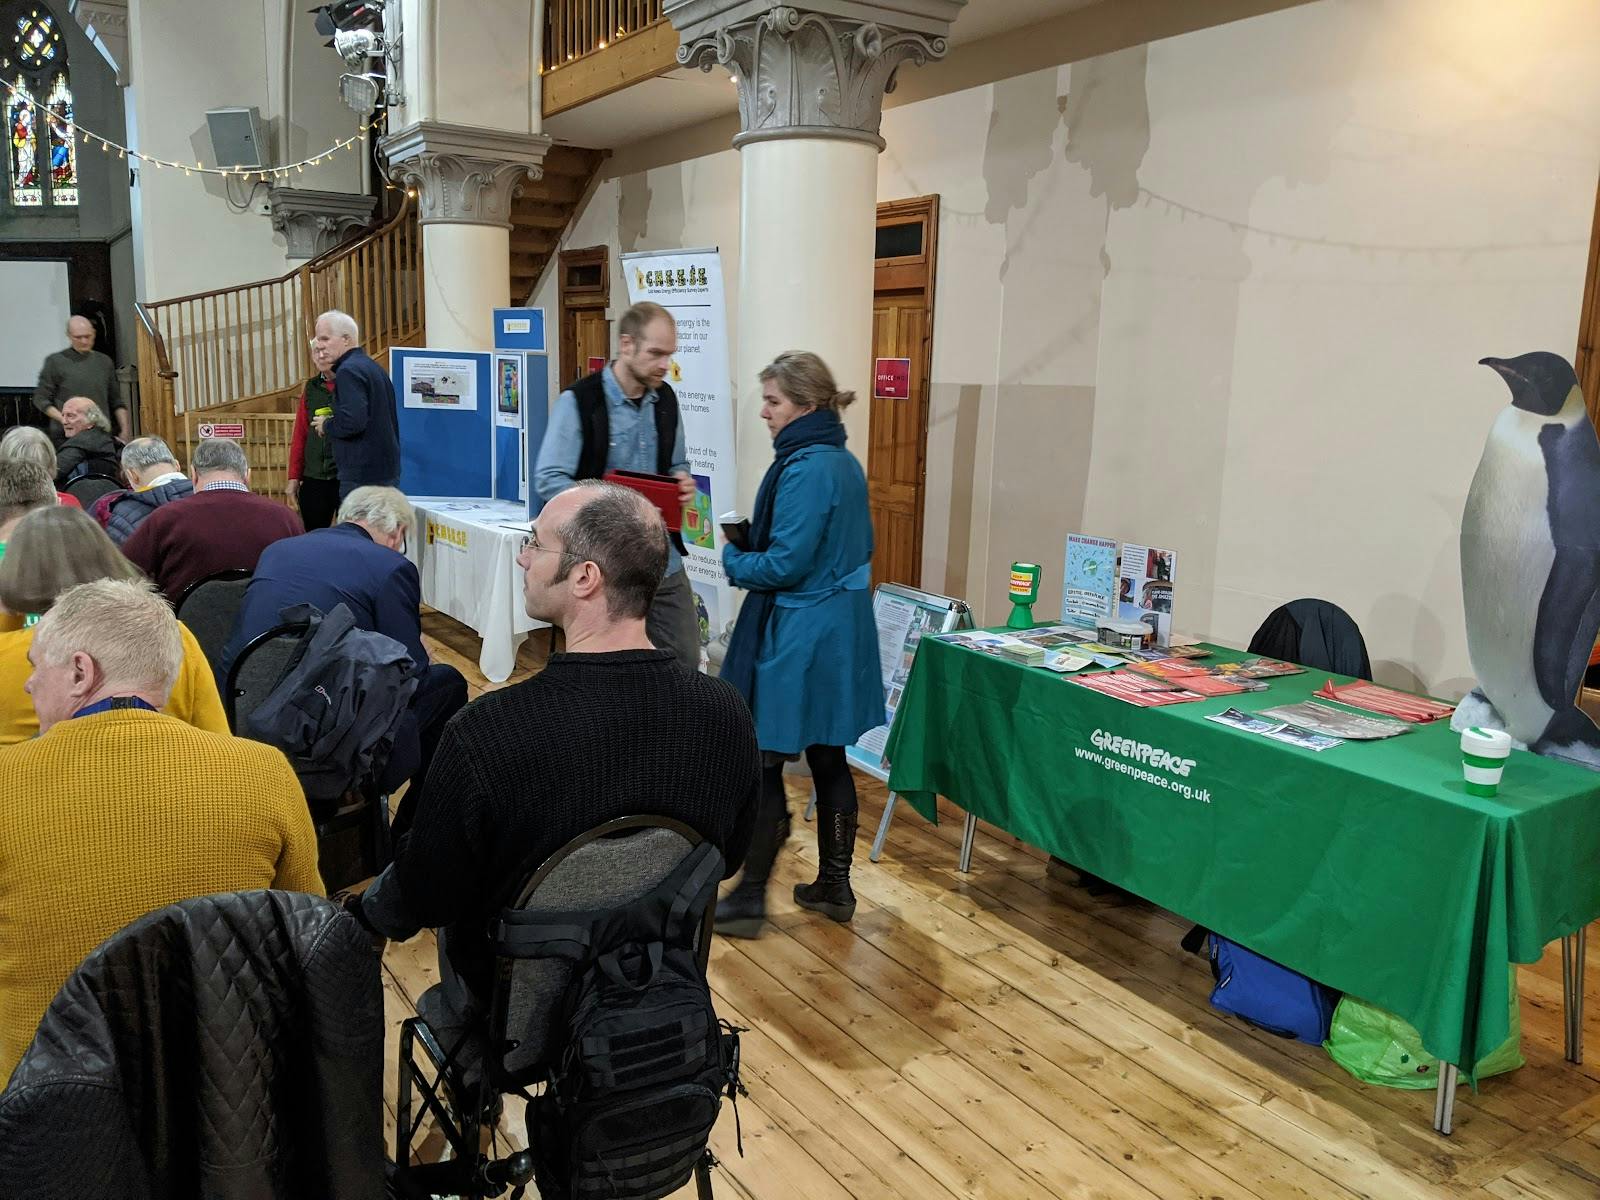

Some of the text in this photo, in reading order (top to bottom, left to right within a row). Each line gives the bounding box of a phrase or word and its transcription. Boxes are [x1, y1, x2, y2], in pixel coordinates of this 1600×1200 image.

[677, 320, 694, 328] energy
[702, 318, 710, 327] the
[693, 332, 698, 340] in
[688, 392, 706, 402] energy
[694, 460, 715, 471] heating
[1068, 536, 1116, 549] MAKE CHANGE HAPPEN
[698, 555, 716, 566] reduce
[699, 568, 716, 580] energy
[1090, 728, 1196, 776] GREENPEACE
[1075, 747, 1210, 803] www.greenpeace.org.uk
